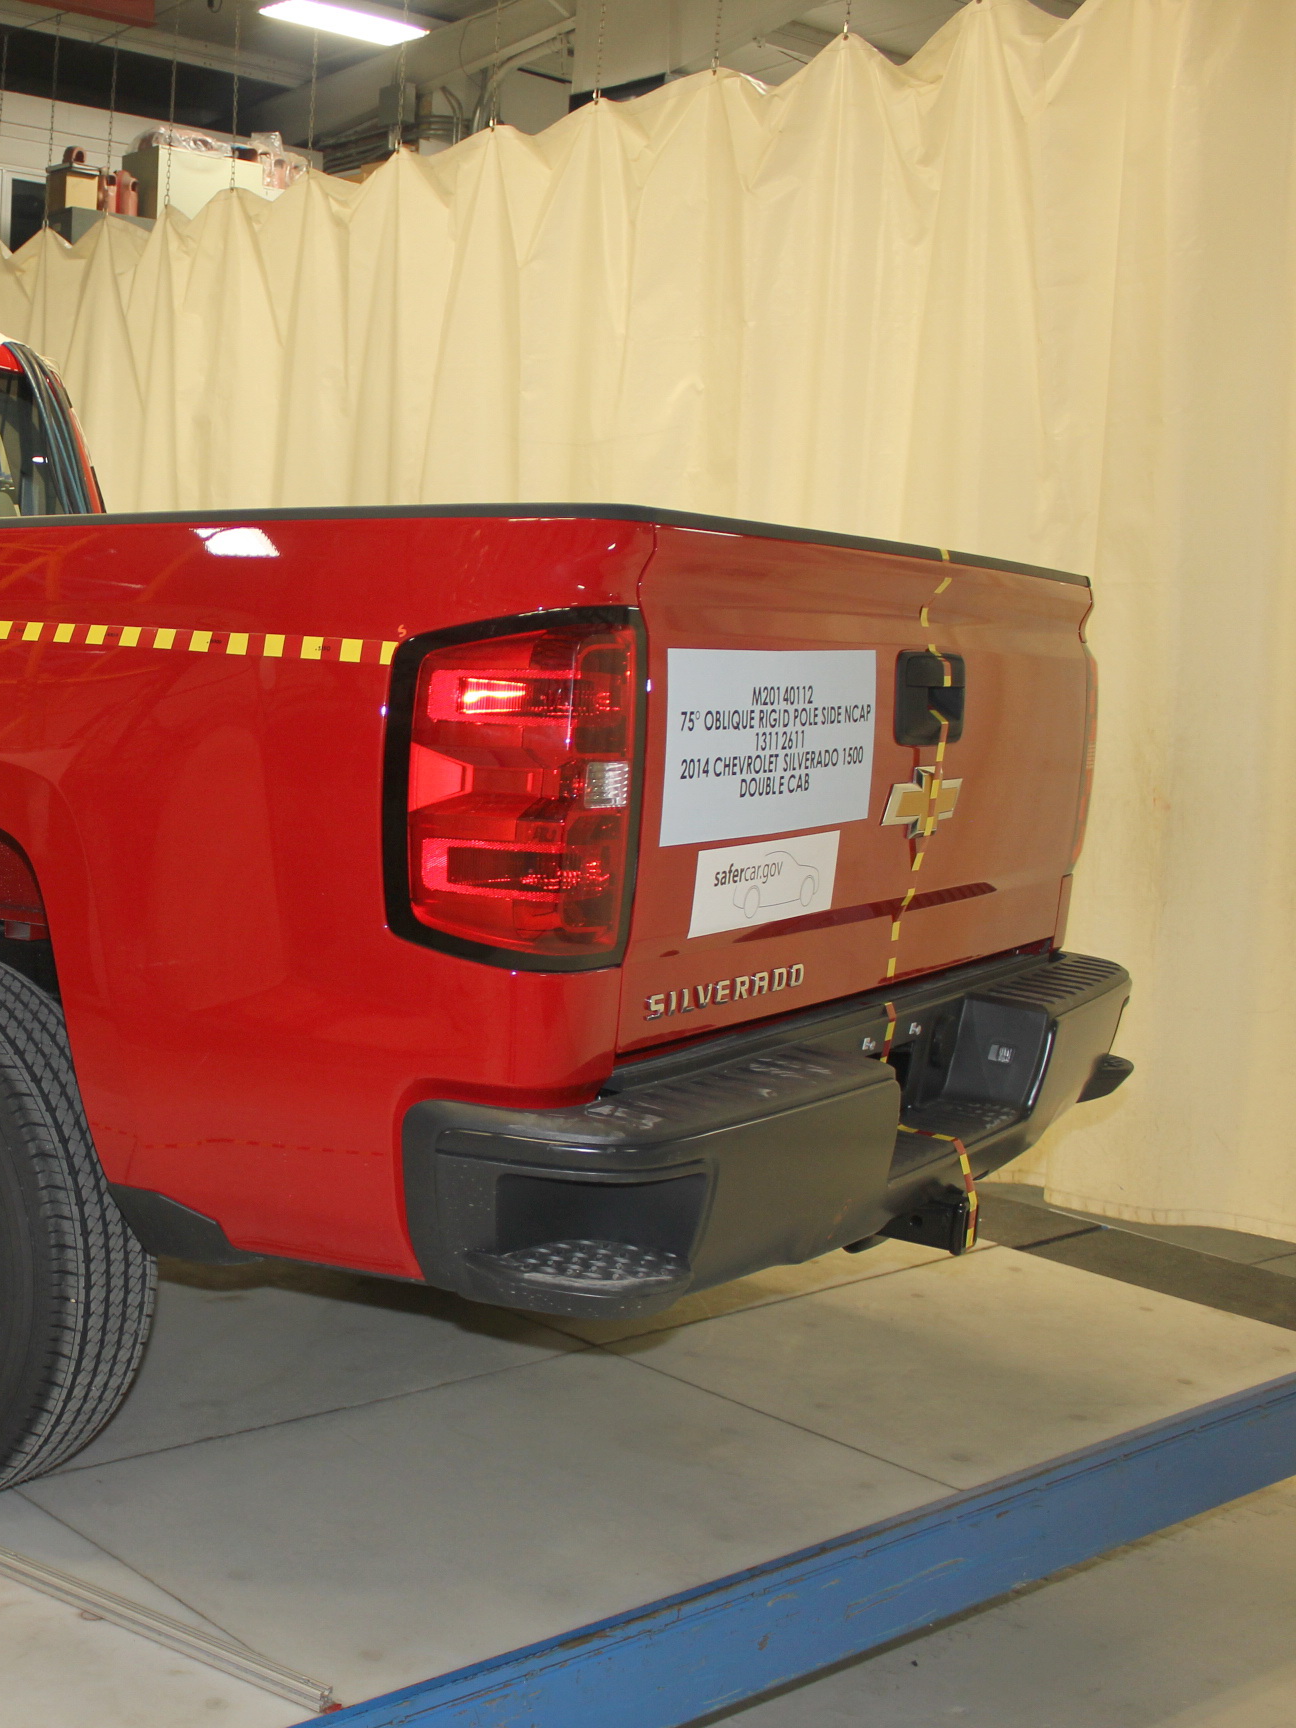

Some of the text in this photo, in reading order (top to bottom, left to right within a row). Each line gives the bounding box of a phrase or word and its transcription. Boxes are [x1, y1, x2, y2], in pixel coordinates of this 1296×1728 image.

[751, 685, 814, 706] M20140112
[680, 703, 872, 732] 75° OBLIQUE RIGID POLE SIDE NCAP
[755, 729, 805, 752] 13112611
[680, 745, 864, 780] 2014 CHEVROLET SILVERADO 1500
[739, 772, 810, 798] DOUBLE CAB
[713, 861, 784, 887] safercar.gov
[644, 963, 805, 1022] SILVERADO
